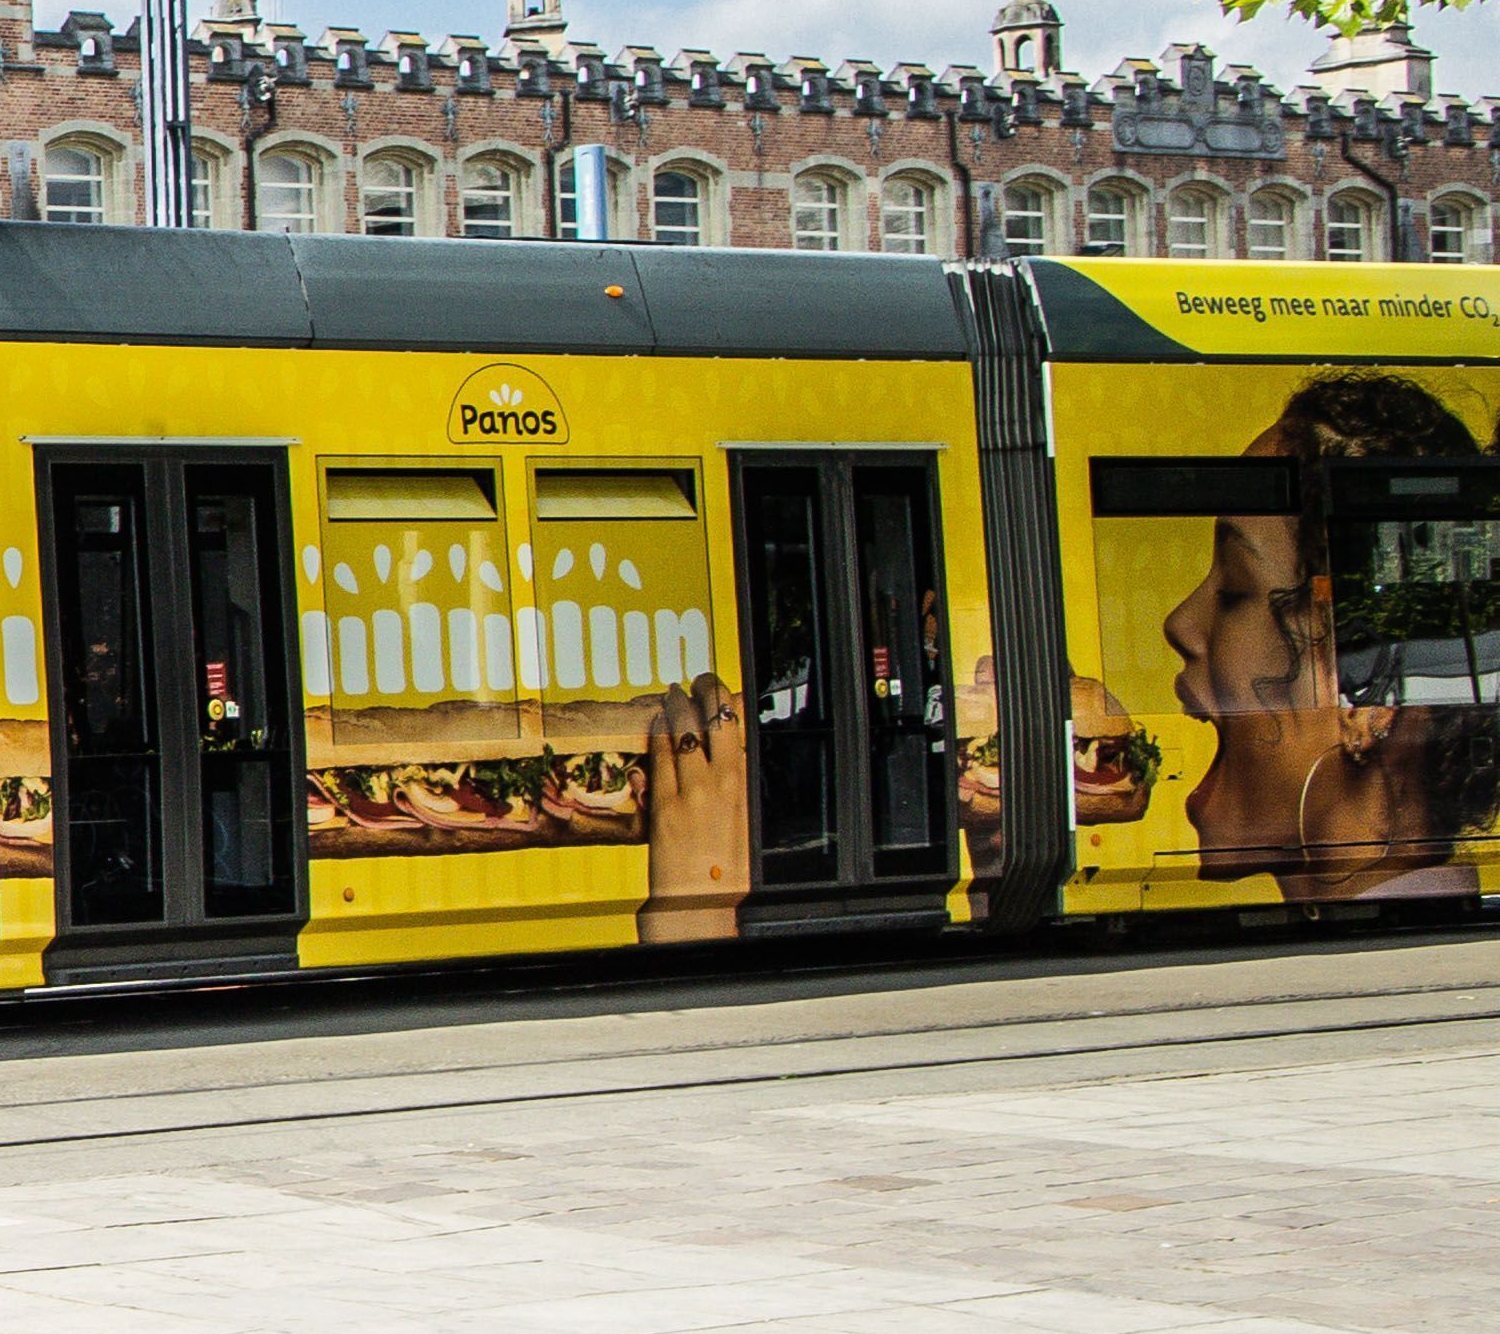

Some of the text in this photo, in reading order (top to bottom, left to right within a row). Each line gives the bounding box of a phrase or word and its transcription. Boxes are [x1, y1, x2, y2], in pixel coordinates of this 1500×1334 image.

[1177, 292, 1267, 323] Beweeg
[1270, 297, 1316, 316] mee
[1322, 298, 1370, 317] naar
[1379, 294, 1453, 318] minder
[461, 405, 558, 436] Panos
